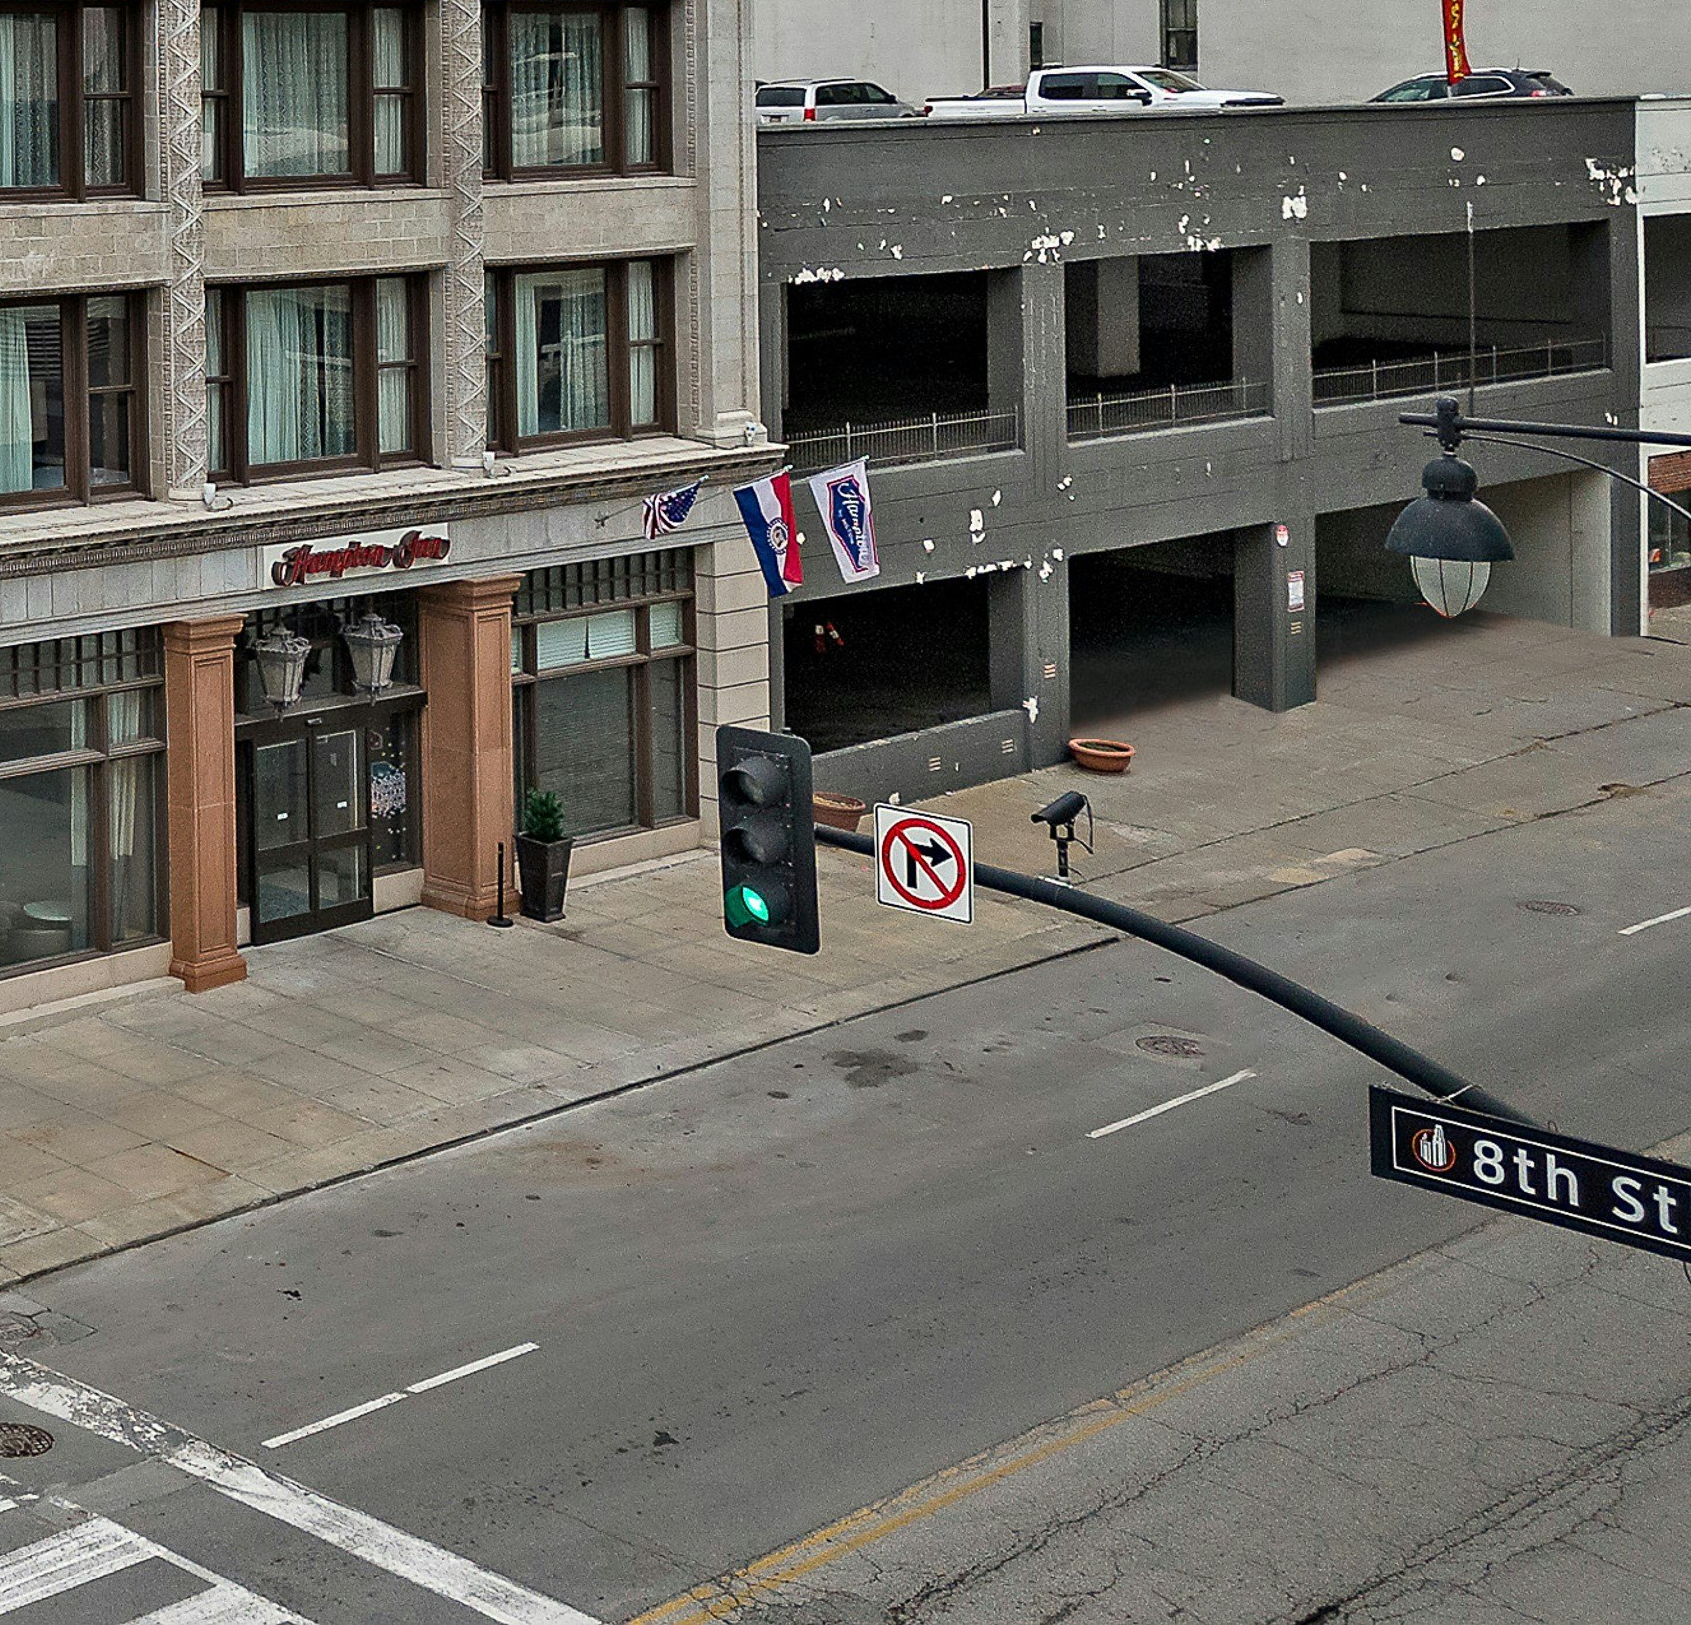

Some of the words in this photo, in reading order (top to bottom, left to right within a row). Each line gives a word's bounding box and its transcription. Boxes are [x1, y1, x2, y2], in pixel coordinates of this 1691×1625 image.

[271, 544, 392, 586] Hampton
[392, 530, 451, 569] Inn
[836, 482, 869, 568] Hampton
[1473, 1140, 1580, 1207] 8th
[1611, 1176, 1679, 1234] St
